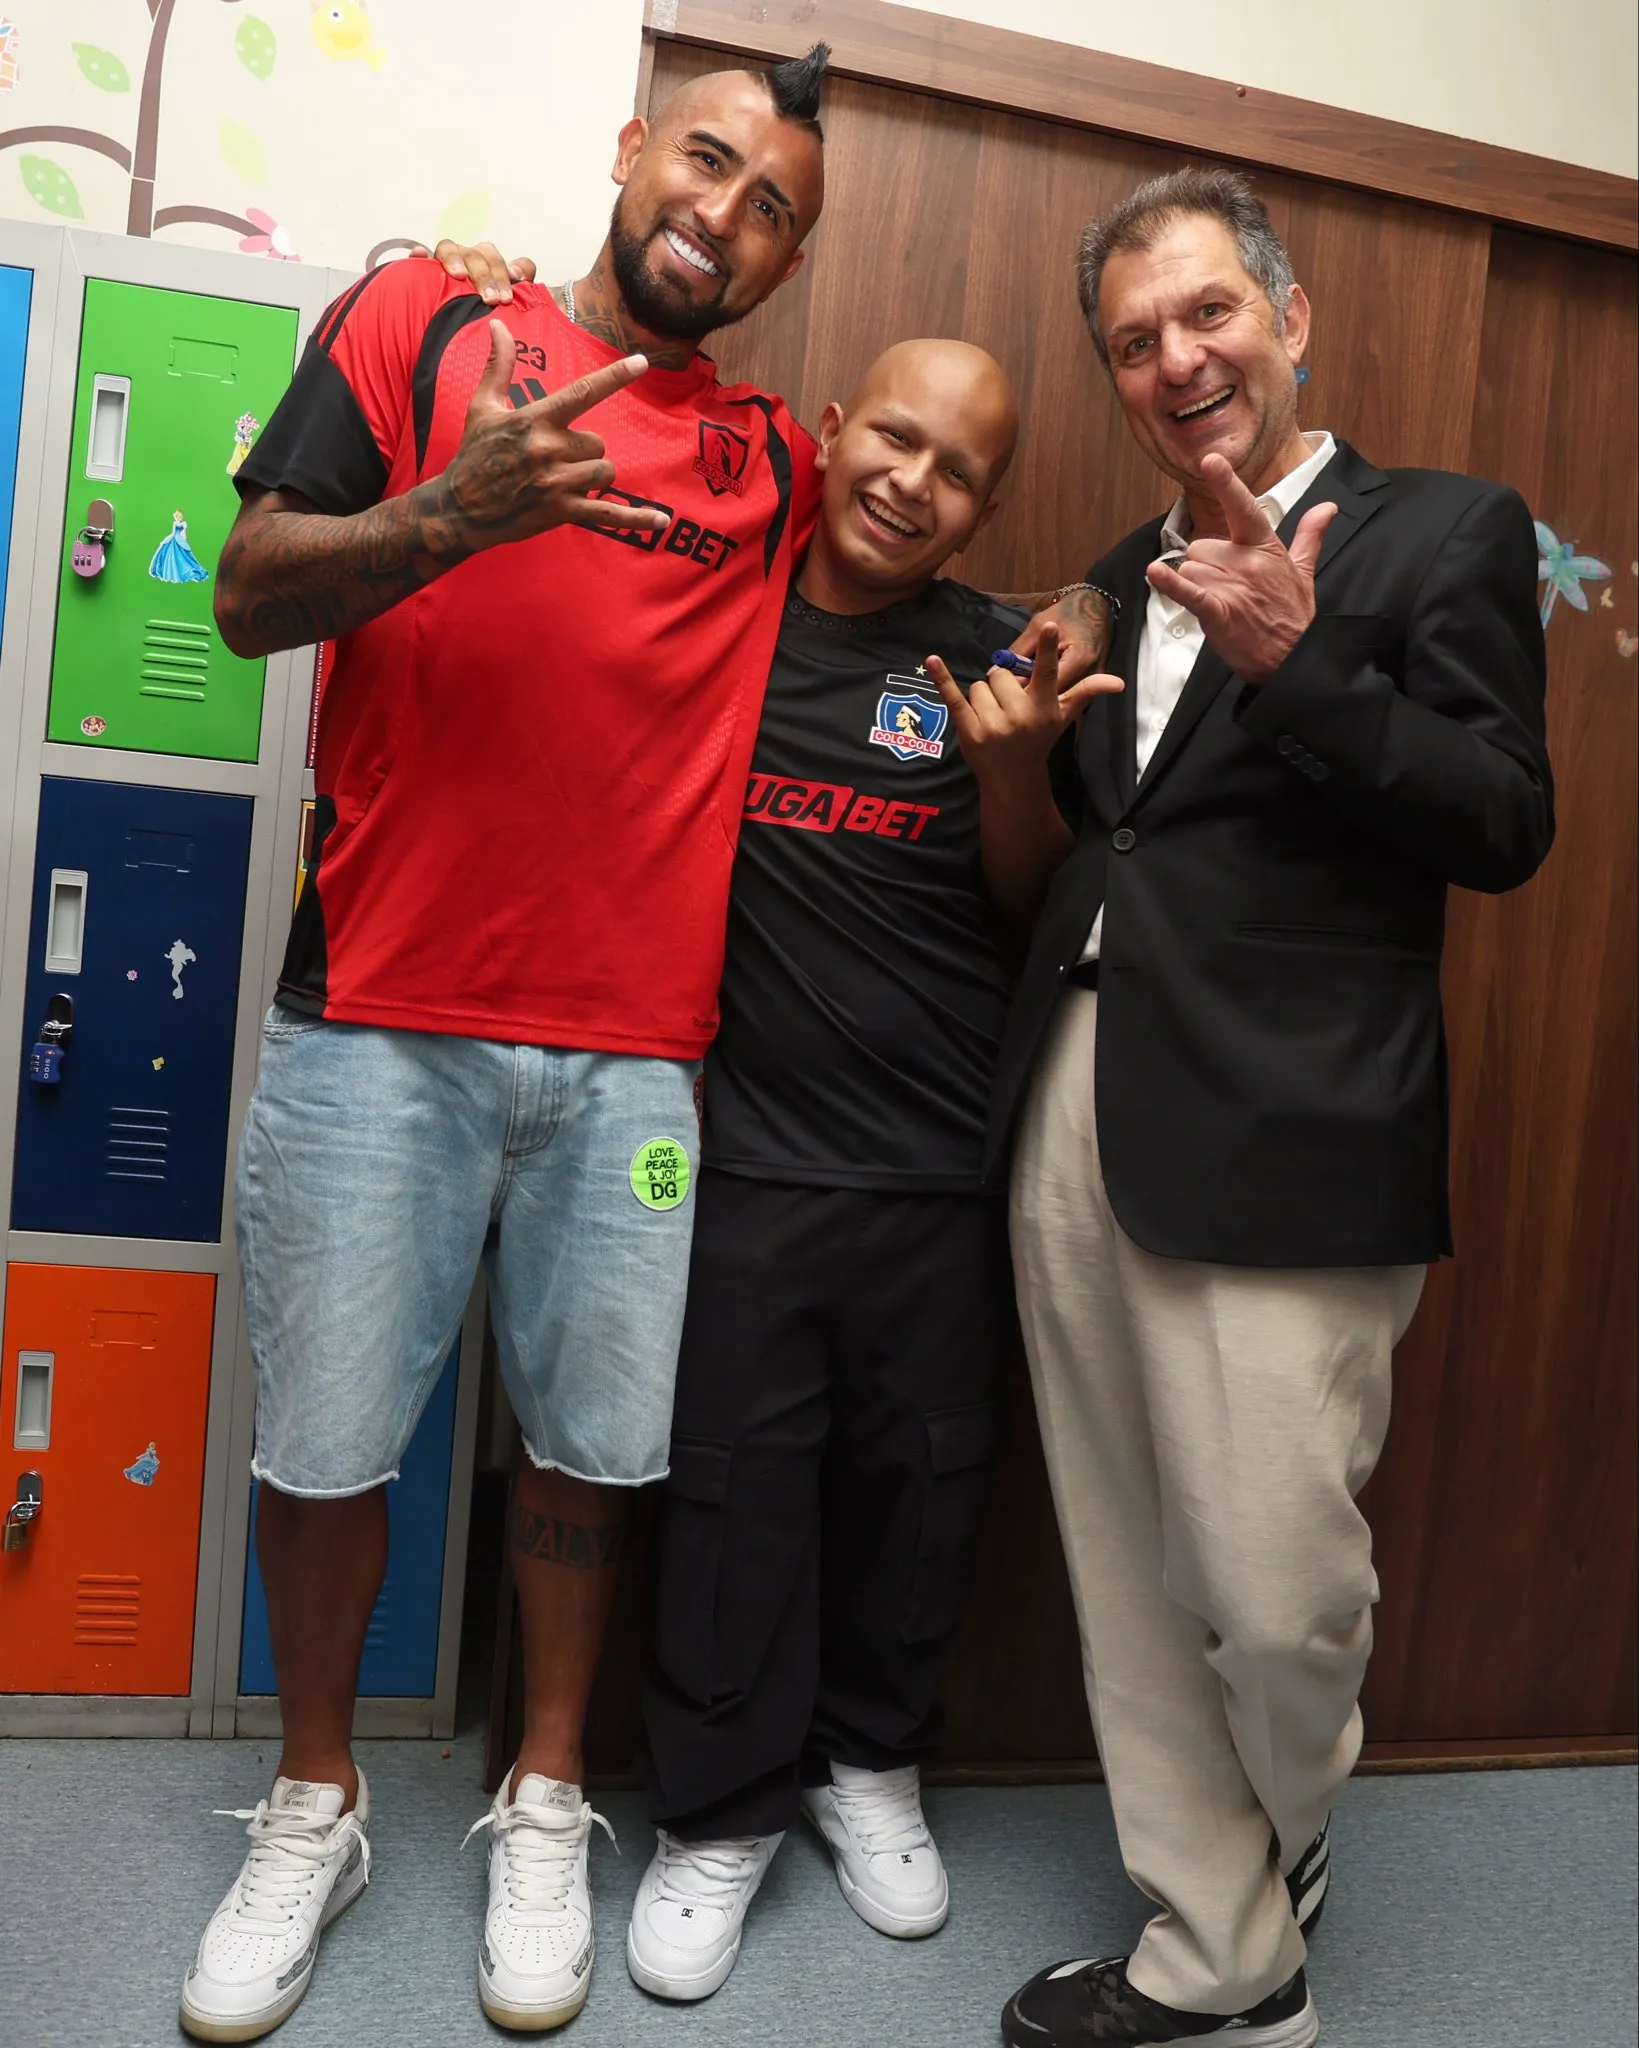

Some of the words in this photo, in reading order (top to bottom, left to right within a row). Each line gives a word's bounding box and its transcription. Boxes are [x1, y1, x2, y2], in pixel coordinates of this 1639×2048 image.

[513, 340, 546, 371] 23
[874, 731, 938, 754] COLO-COLO
[649, 1147, 675, 1159] LOVE
[645, 1158, 679, 1171] PEACE
[648, 1171, 657, 1181] &
[660, 1169, 677, 1180] JOY
[651, 1181, 677, 1200] DG
